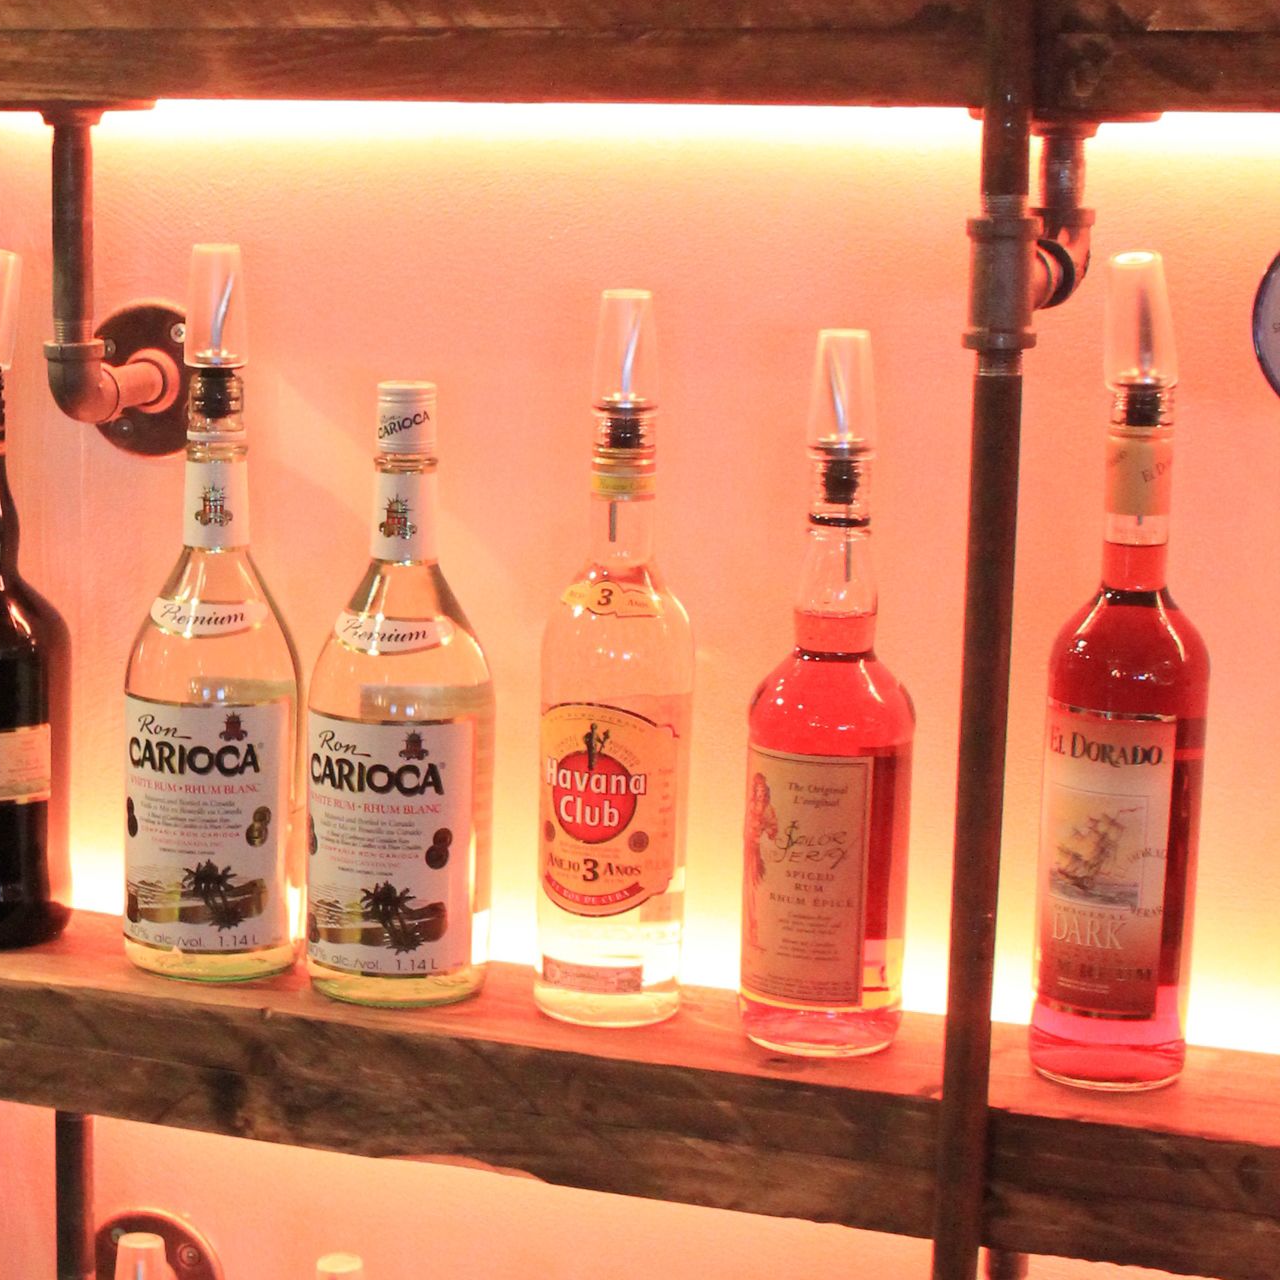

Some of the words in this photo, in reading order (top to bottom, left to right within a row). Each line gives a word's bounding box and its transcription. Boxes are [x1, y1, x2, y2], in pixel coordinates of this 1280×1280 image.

[377, 409, 431, 439] CARIOCA
[598, 588, 613, 605] 3
[161, 603, 245, 628] Premium
[341, 618, 429, 643] Premium
[138, 714, 192, 739] Ron
[129, 737, 260, 777] CARIOCA
[319, 730, 371, 757] Ron
[1071, 731, 1164, 768] DORADO
[310, 753, 445, 797] CARIOCA
[546, 757, 647, 795] Havana
[184, 783, 221, 795] RHUM
[363, 802, 401, 815] RHUM
[559, 794, 620, 828] Club
[582, 858, 600, 882] 3
[1052, 912, 1124, 950] DARK
